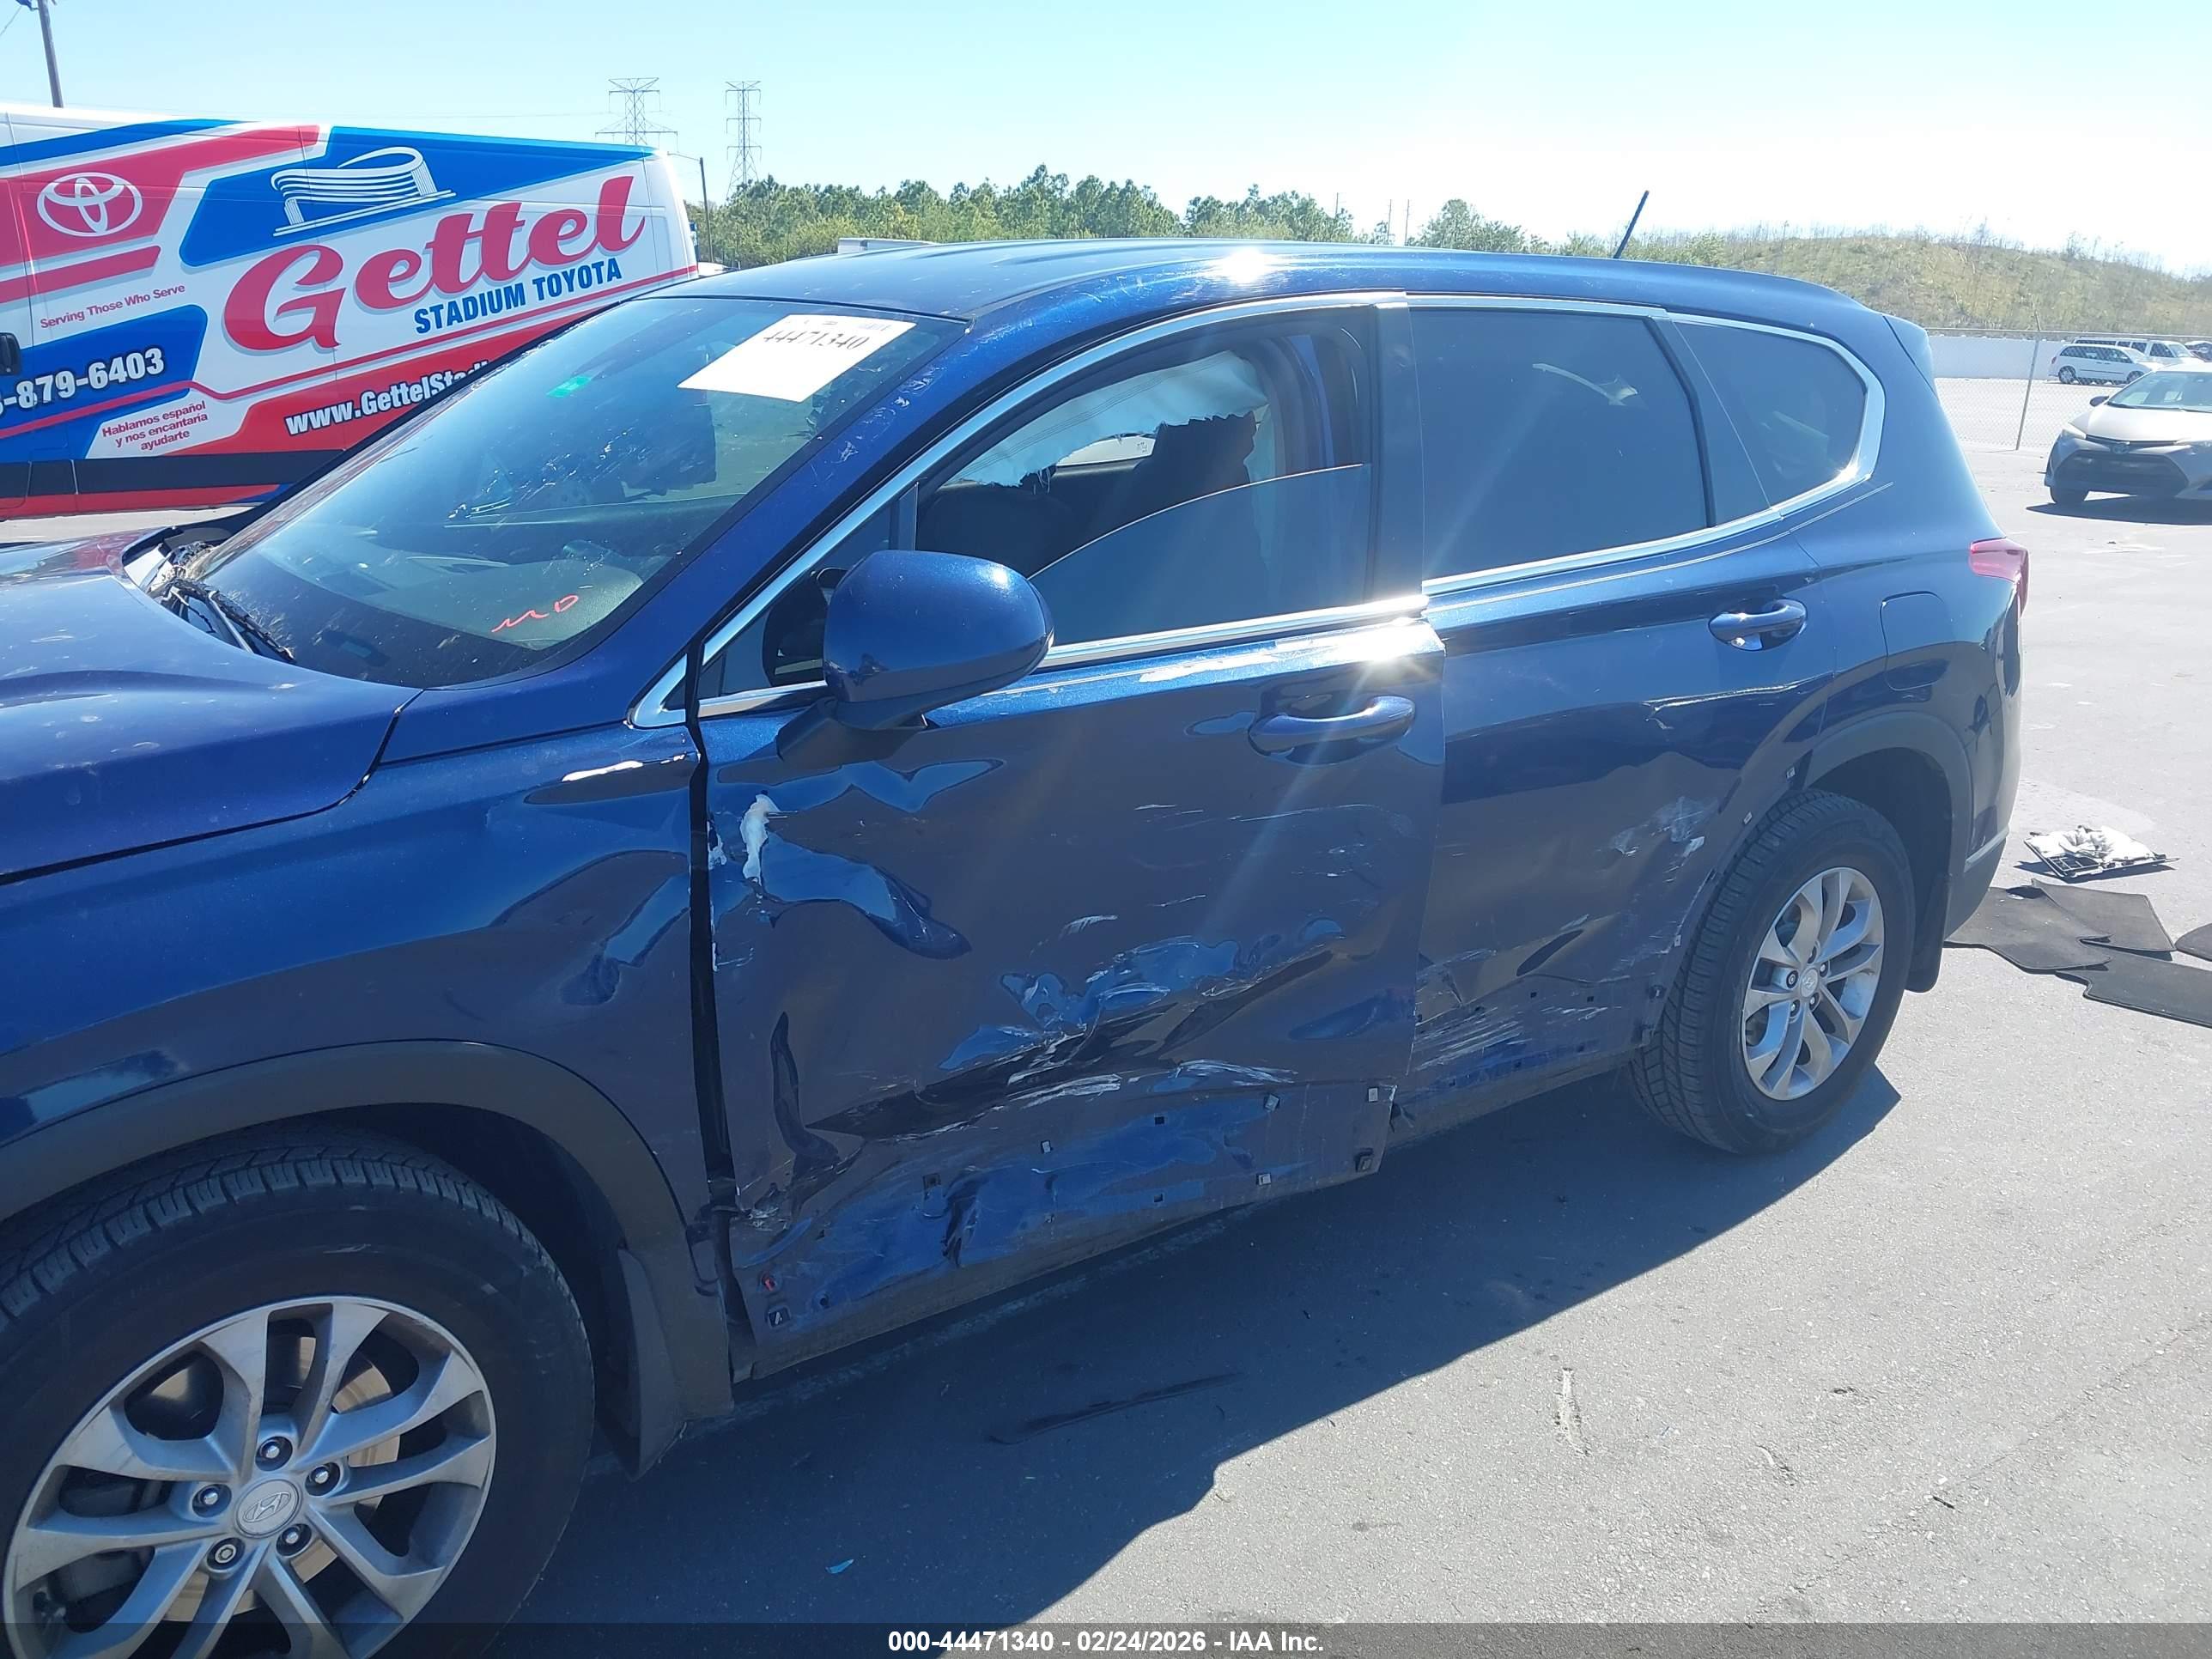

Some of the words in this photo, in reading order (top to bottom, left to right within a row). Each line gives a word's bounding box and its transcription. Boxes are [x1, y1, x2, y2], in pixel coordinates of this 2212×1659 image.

[223, 176, 646, 351] Gettel
[40, 310, 84, 329] Serving
[87, 300, 124, 316] Those
[125, 294, 151, 307] Who
[153, 284, 185, 299] Serve
[414, 283, 526, 334] STADIUM
[532, 258, 622, 301] TOYOTA
[0, 348, 164, 414] -879-6403
[102, 416, 160, 437] Hablamos
[162, 400, 206, 419] español
[115, 438, 123, 447] y
[125, 430, 146, 443] nos
[141, 430, 190, 450] ayudarte
